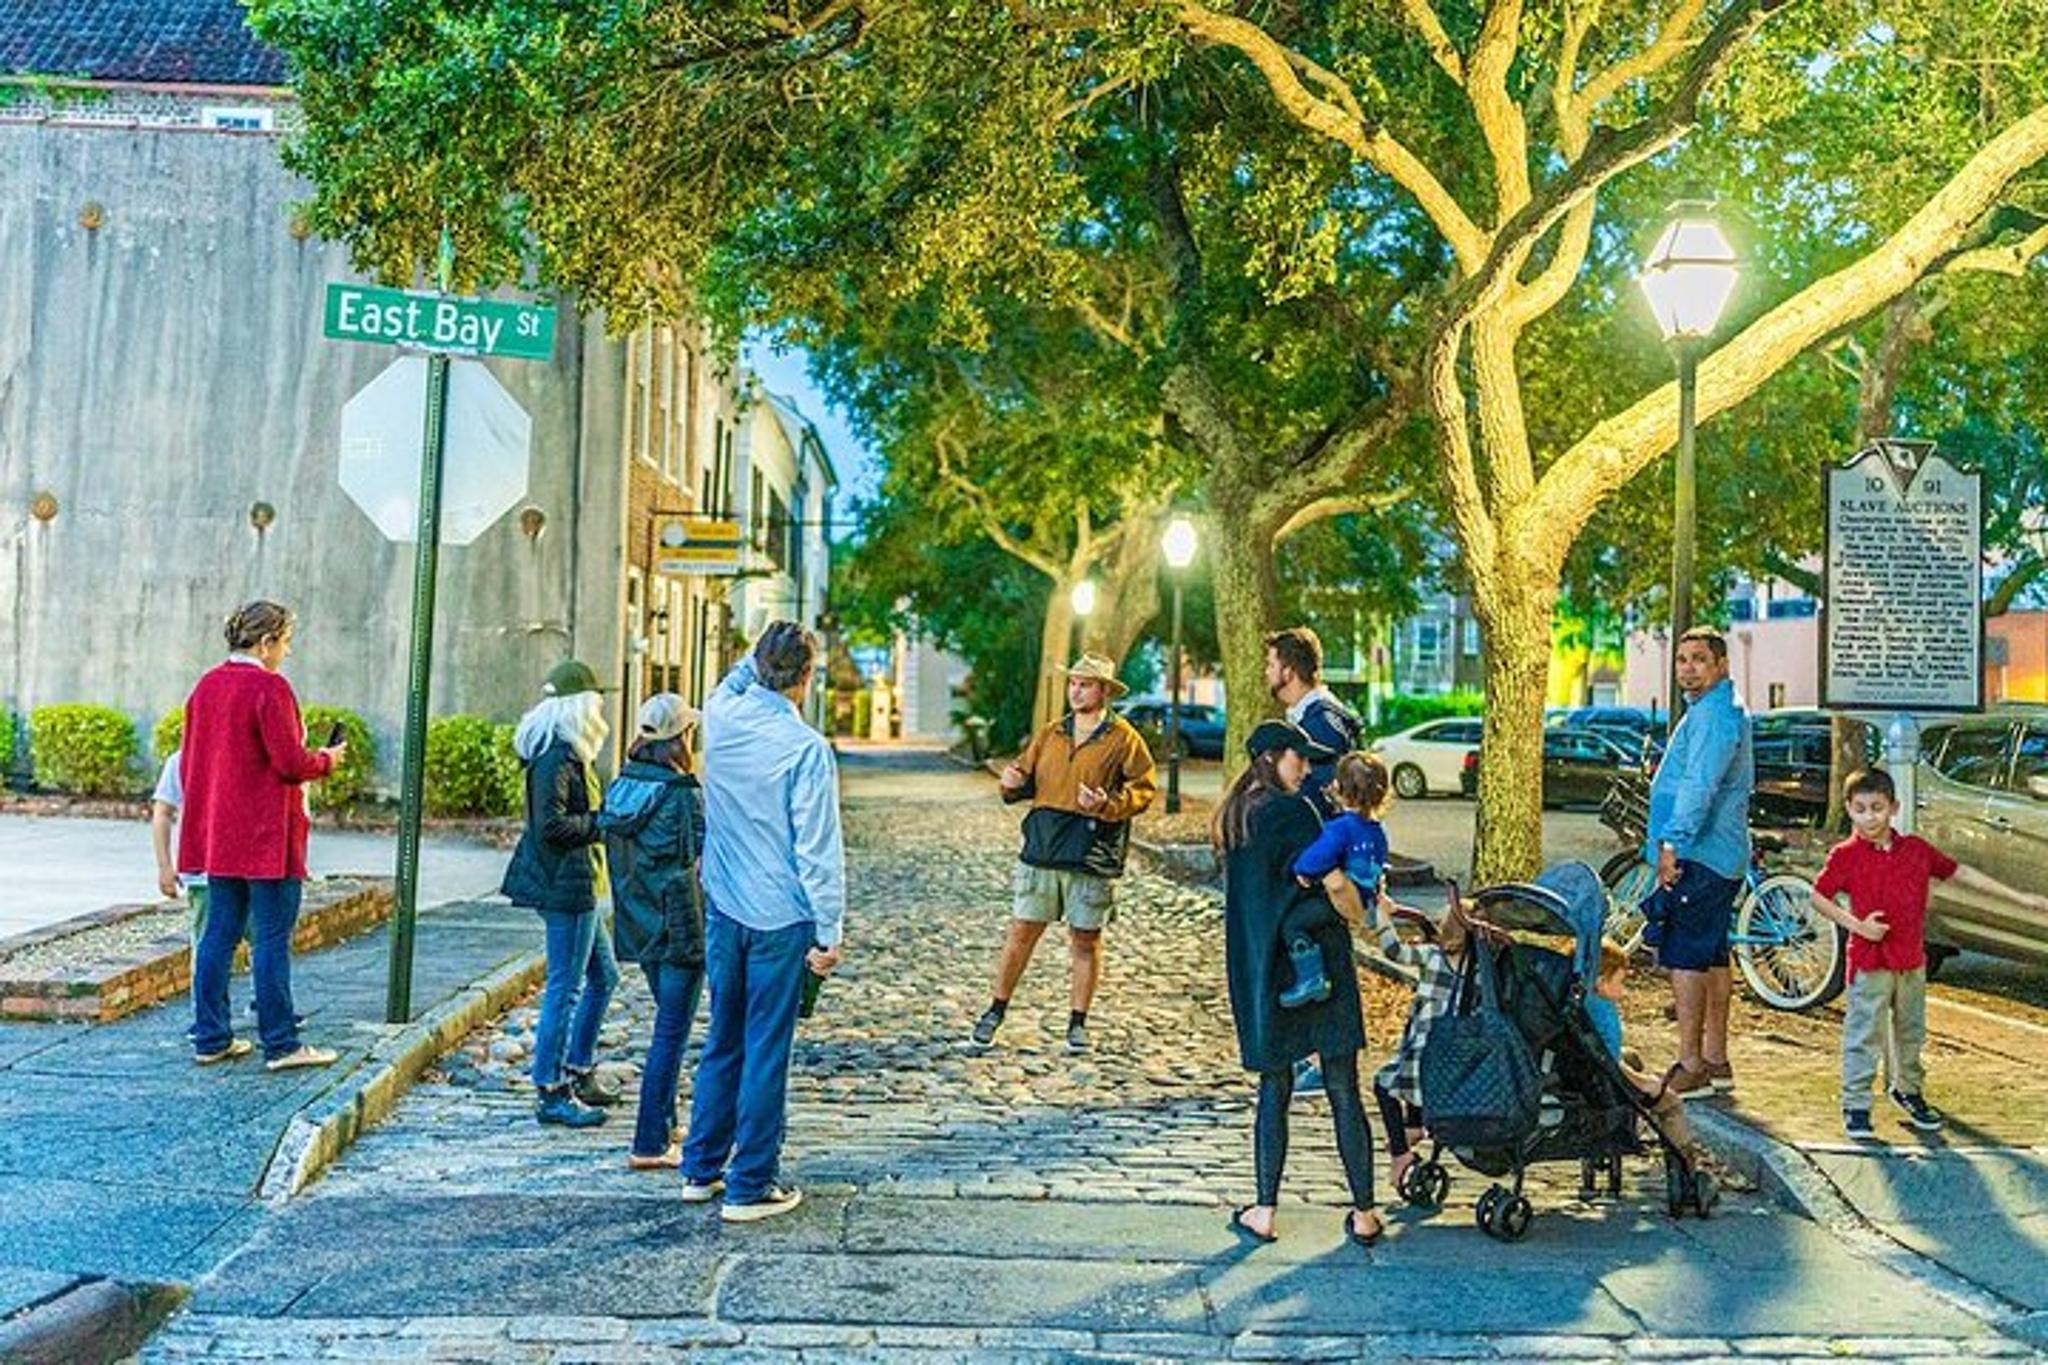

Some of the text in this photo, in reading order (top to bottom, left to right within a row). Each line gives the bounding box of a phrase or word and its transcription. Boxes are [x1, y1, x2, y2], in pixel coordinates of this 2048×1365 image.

[339, 291, 540, 353] East Bay St
[1866, 477, 1941, 494] 10 91
[1840, 500, 1968, 515] SLAVE AUCTIONS
